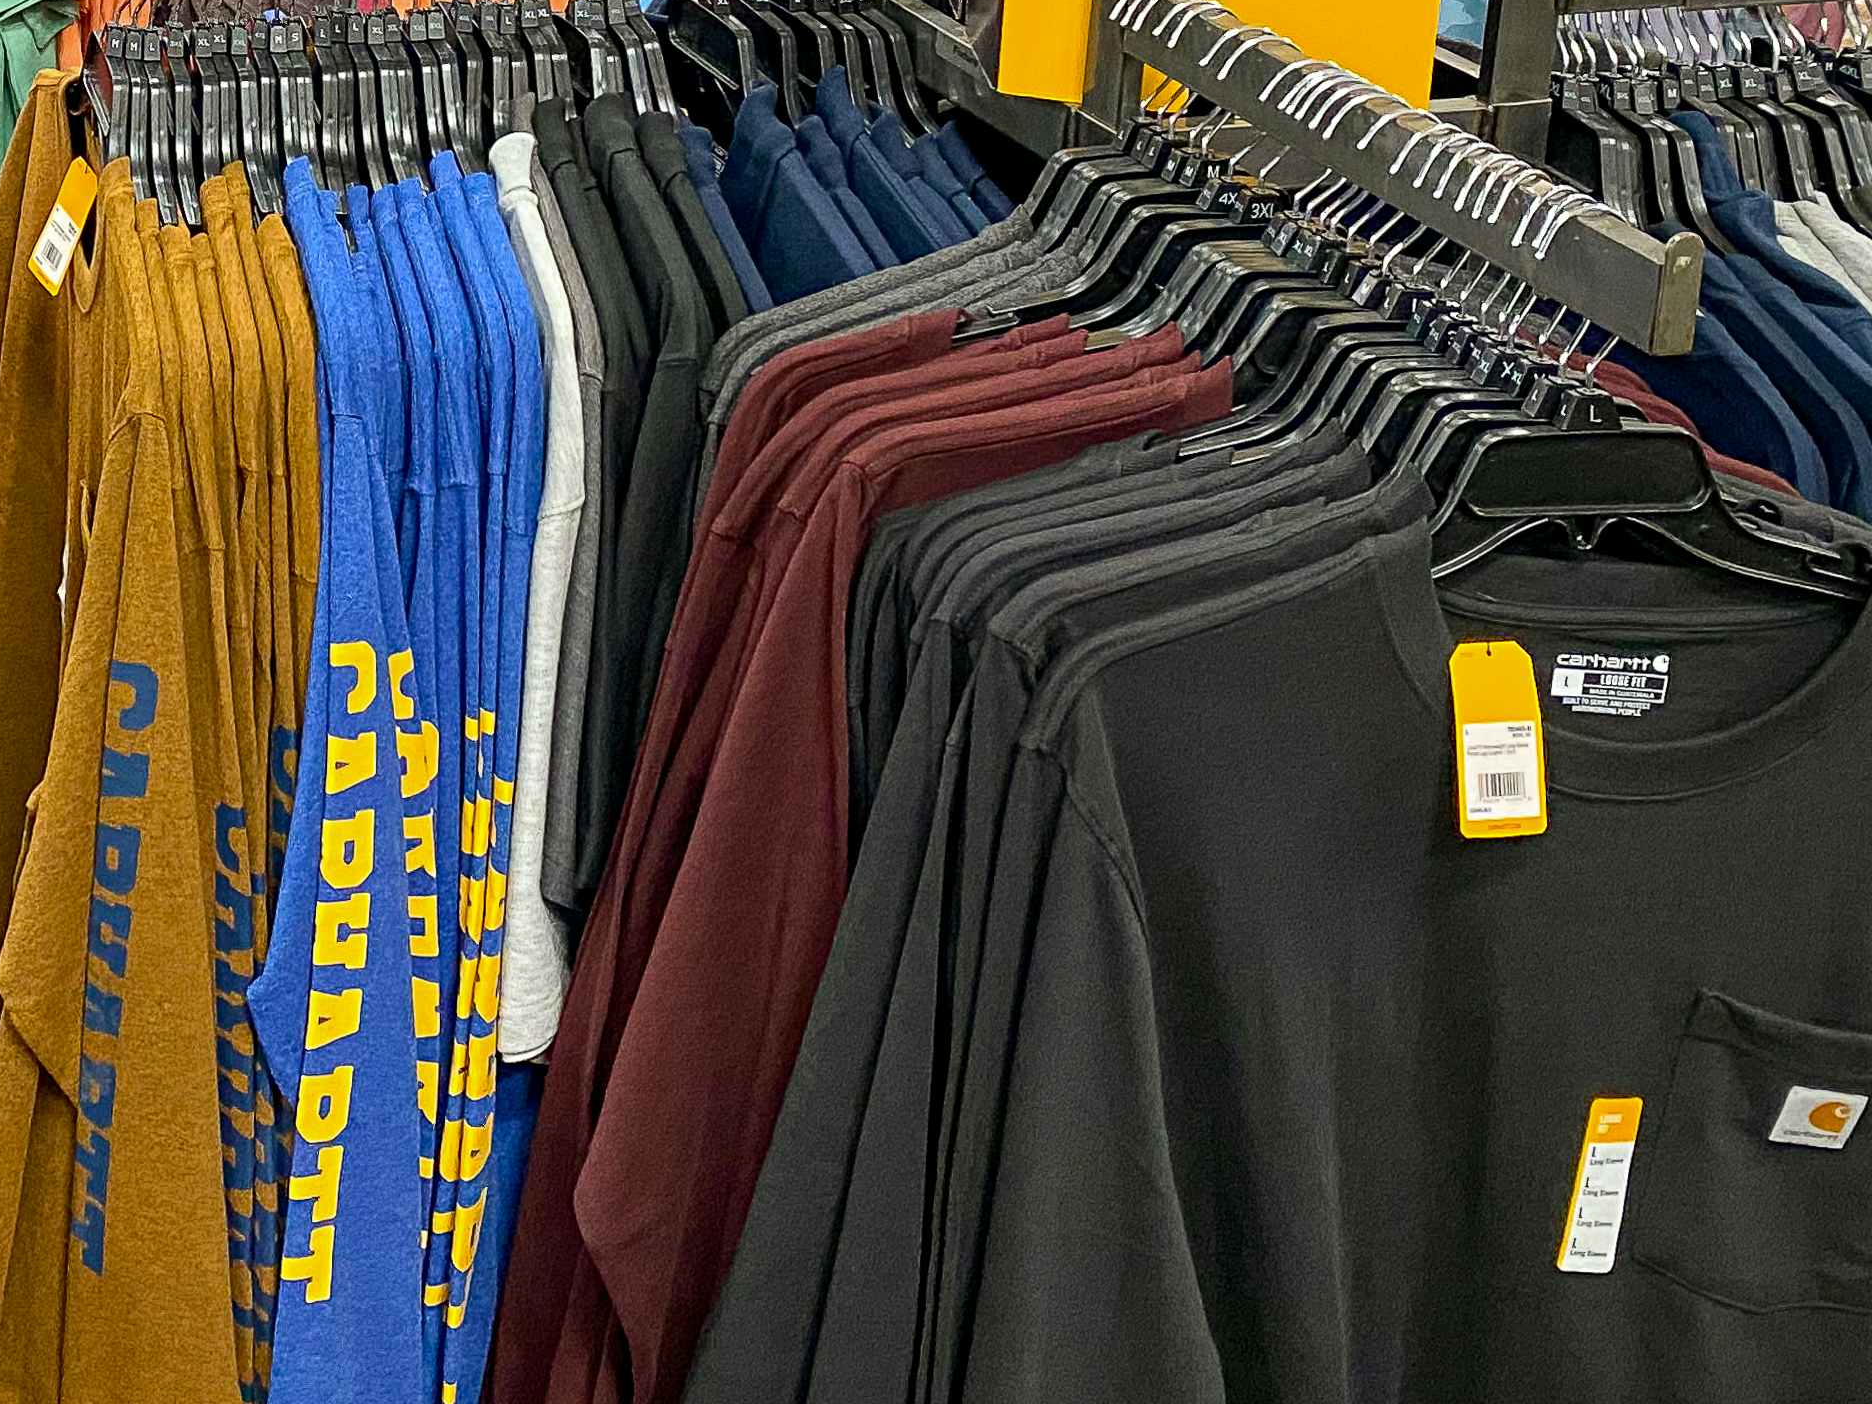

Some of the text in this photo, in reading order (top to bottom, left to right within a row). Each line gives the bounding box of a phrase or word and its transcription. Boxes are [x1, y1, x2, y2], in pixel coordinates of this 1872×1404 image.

[1556, 653, 1652, 672] carhartt
[1600, 674, 1631, 687] LOOSE
[1630, 676, 1648, 688] FIT
